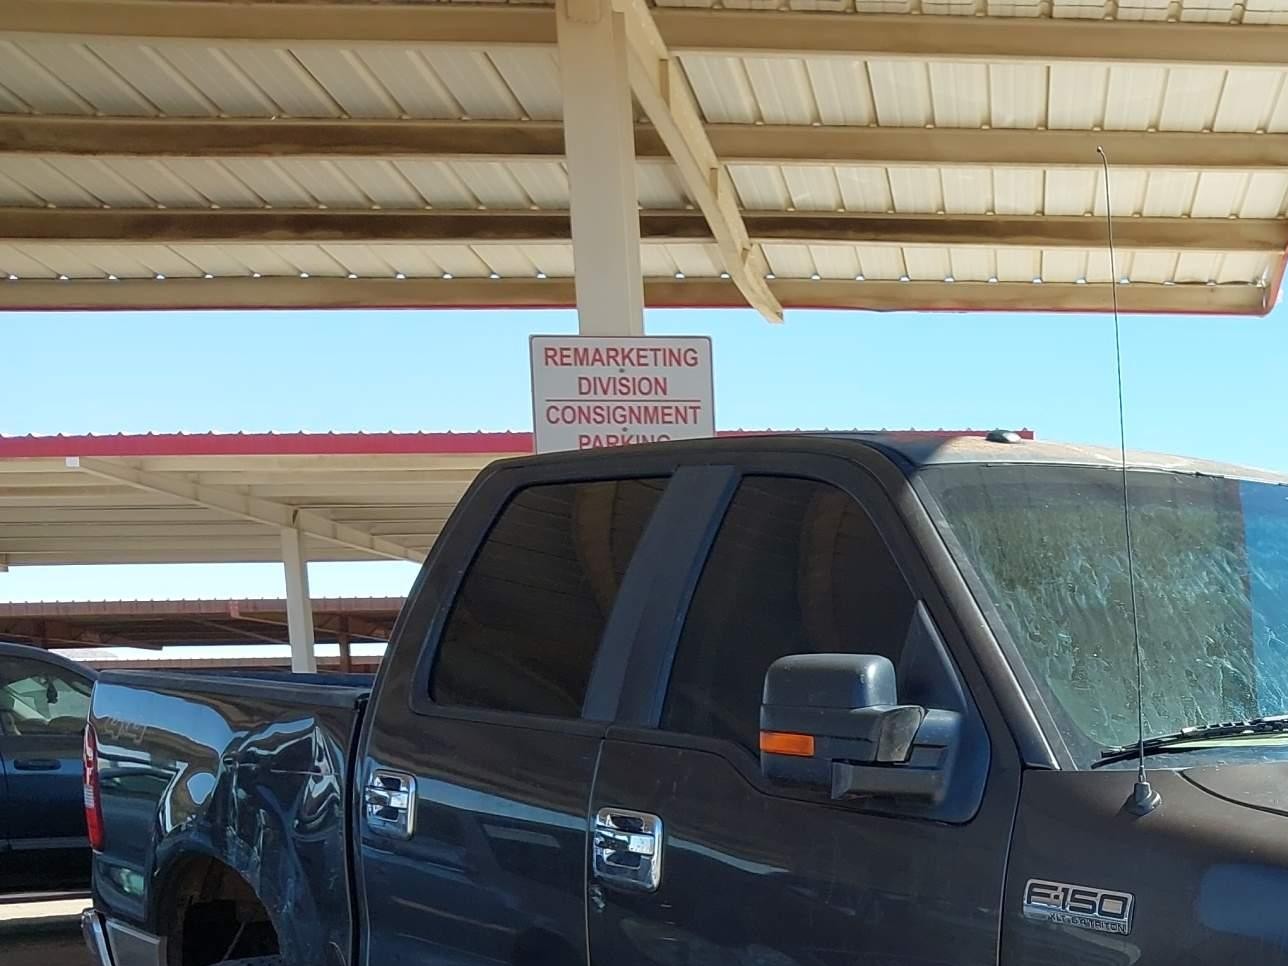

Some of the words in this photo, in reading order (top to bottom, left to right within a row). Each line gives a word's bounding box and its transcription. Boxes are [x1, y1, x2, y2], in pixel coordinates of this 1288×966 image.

[544, 347, 699, 367] REMARKETING
[578, 376, 668, 396] DIVISION
[546, 405, 702, 425] CONSIGNMENT
[1026, 882, 1129, 919] F-150
